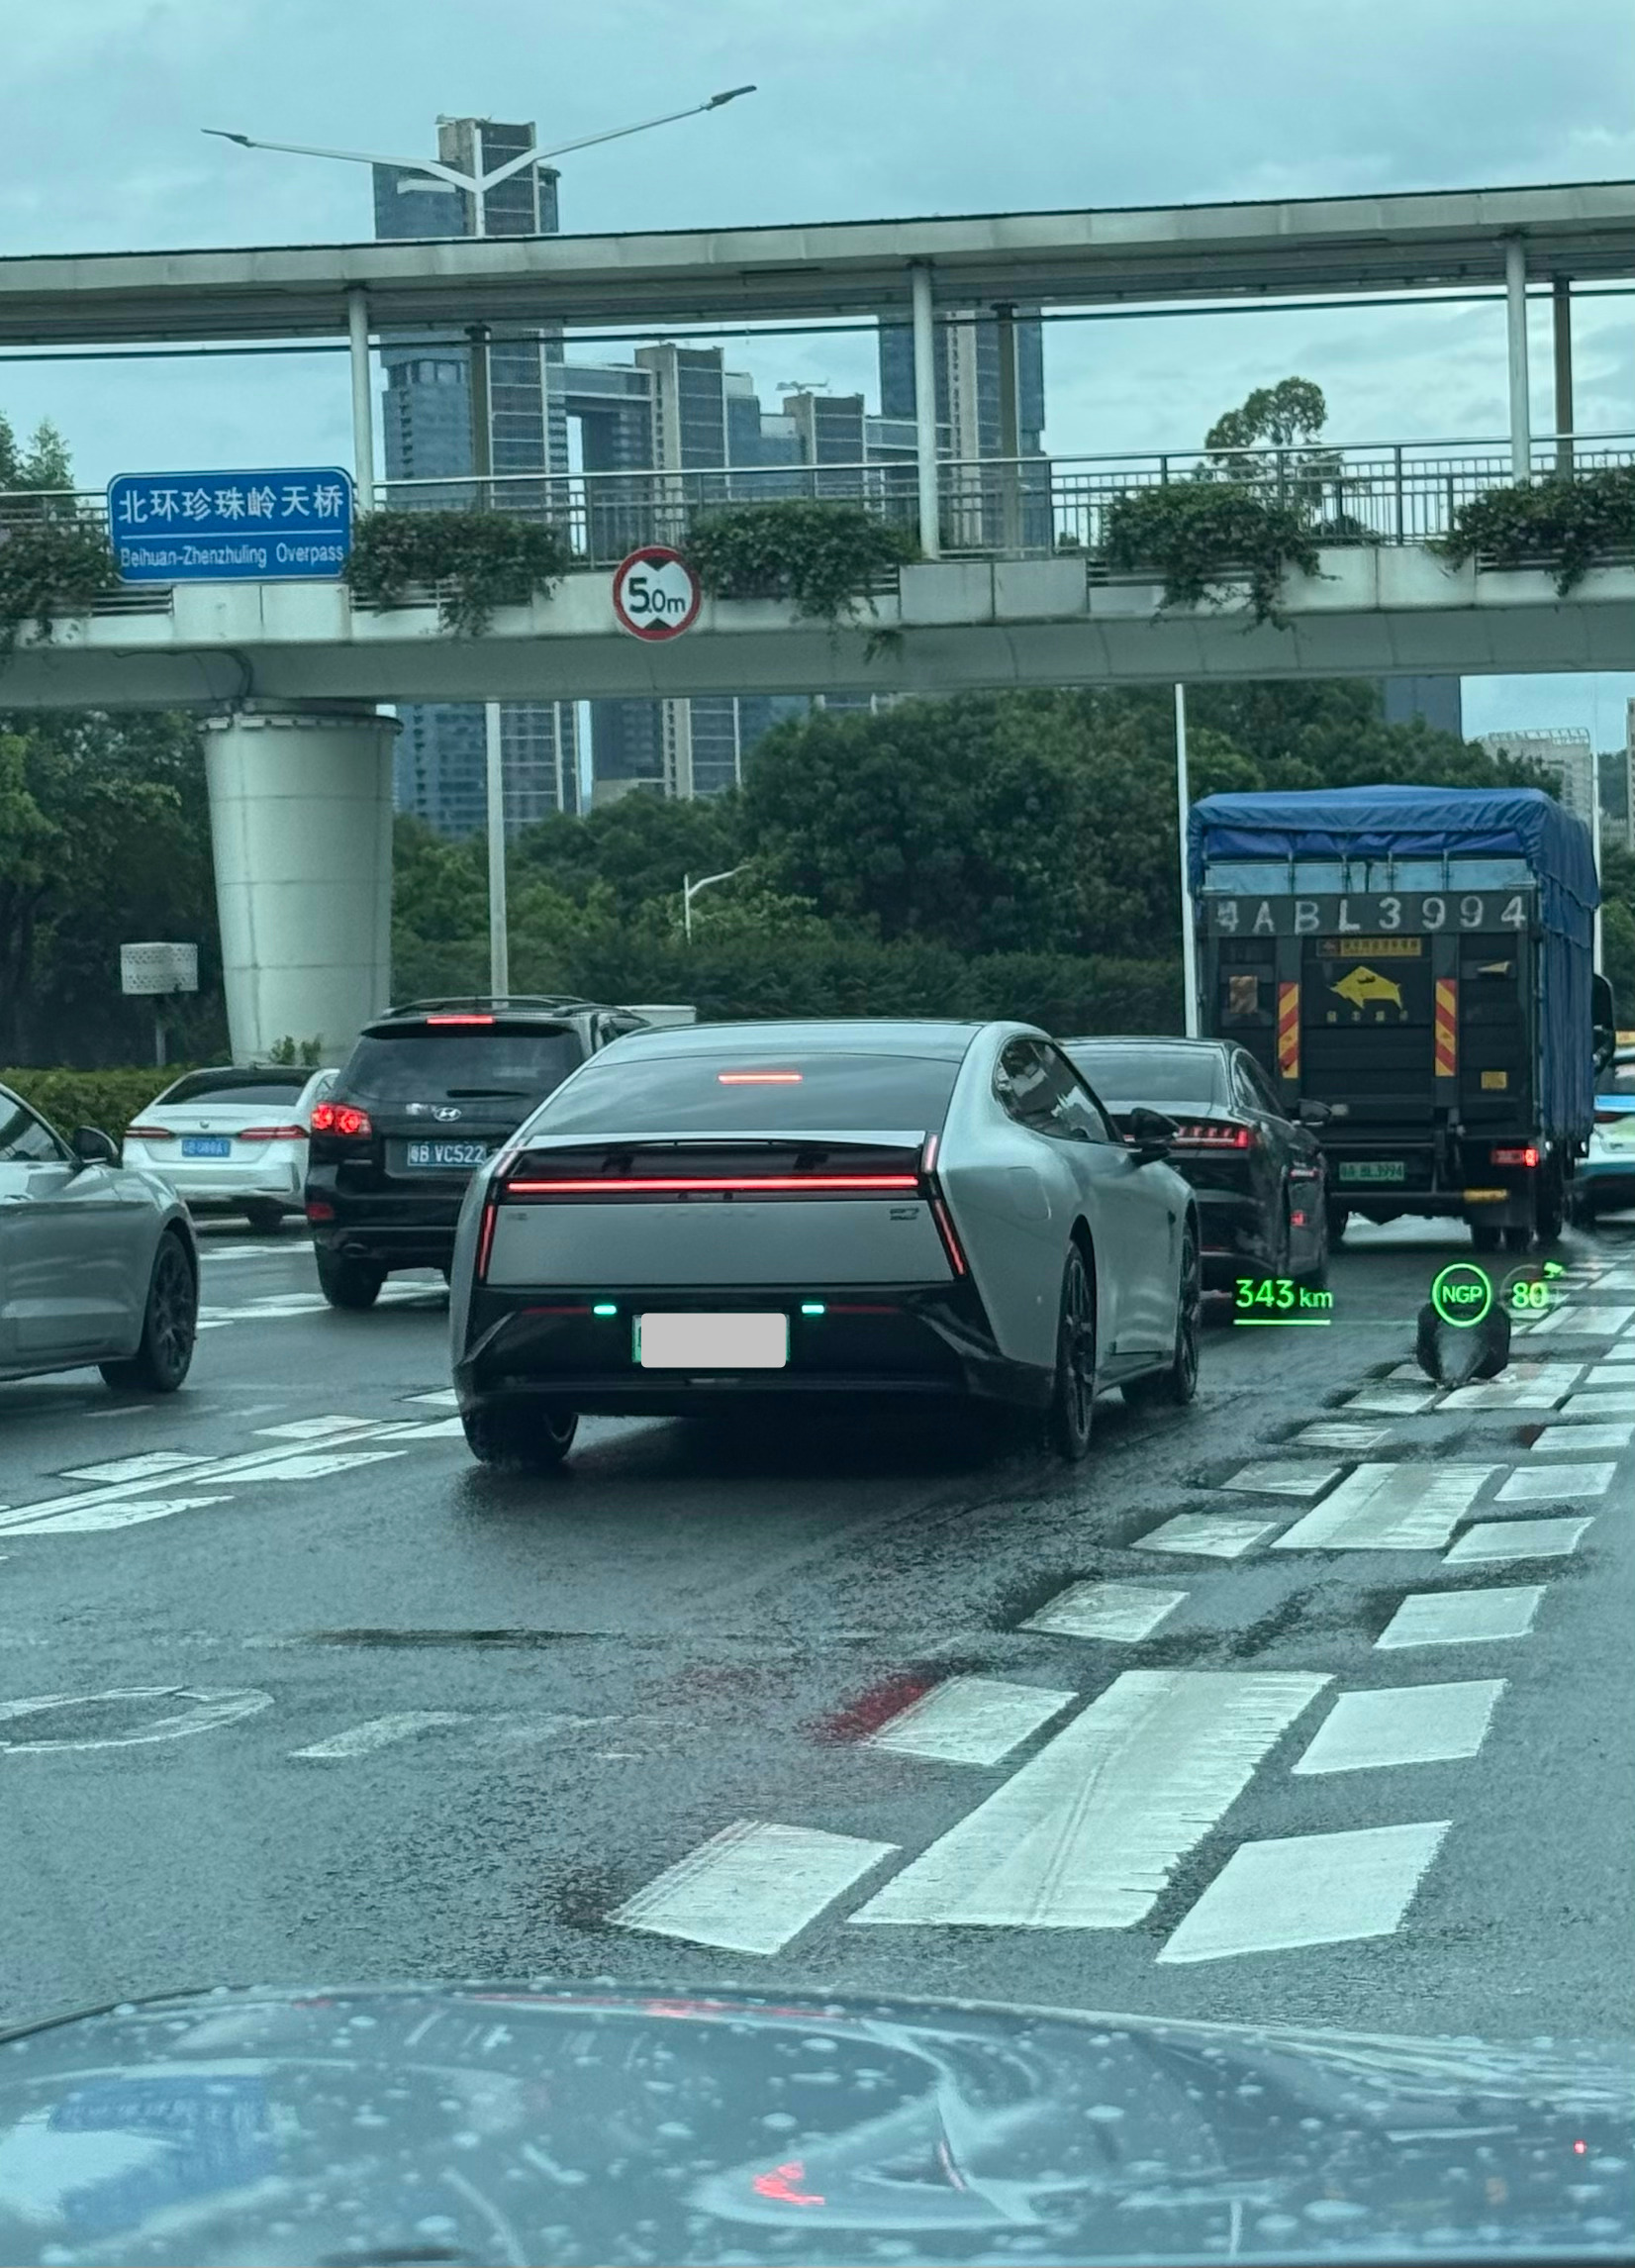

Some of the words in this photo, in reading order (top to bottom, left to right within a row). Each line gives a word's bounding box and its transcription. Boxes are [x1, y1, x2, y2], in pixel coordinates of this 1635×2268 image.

[118, 484, 344, 524] 北环珍珠岭天桥
[120, 544, 267, 569] Beihuan-Zhenzhuling
[275, 542, 344, 566] Overpass
[1235, 1279, 1296, 1309] 343
[1298, 1287, 1334, 1309] km
[1441, 1285, 1484, 1305] NGP
[1511, 1281, 1549, 1309] 80
